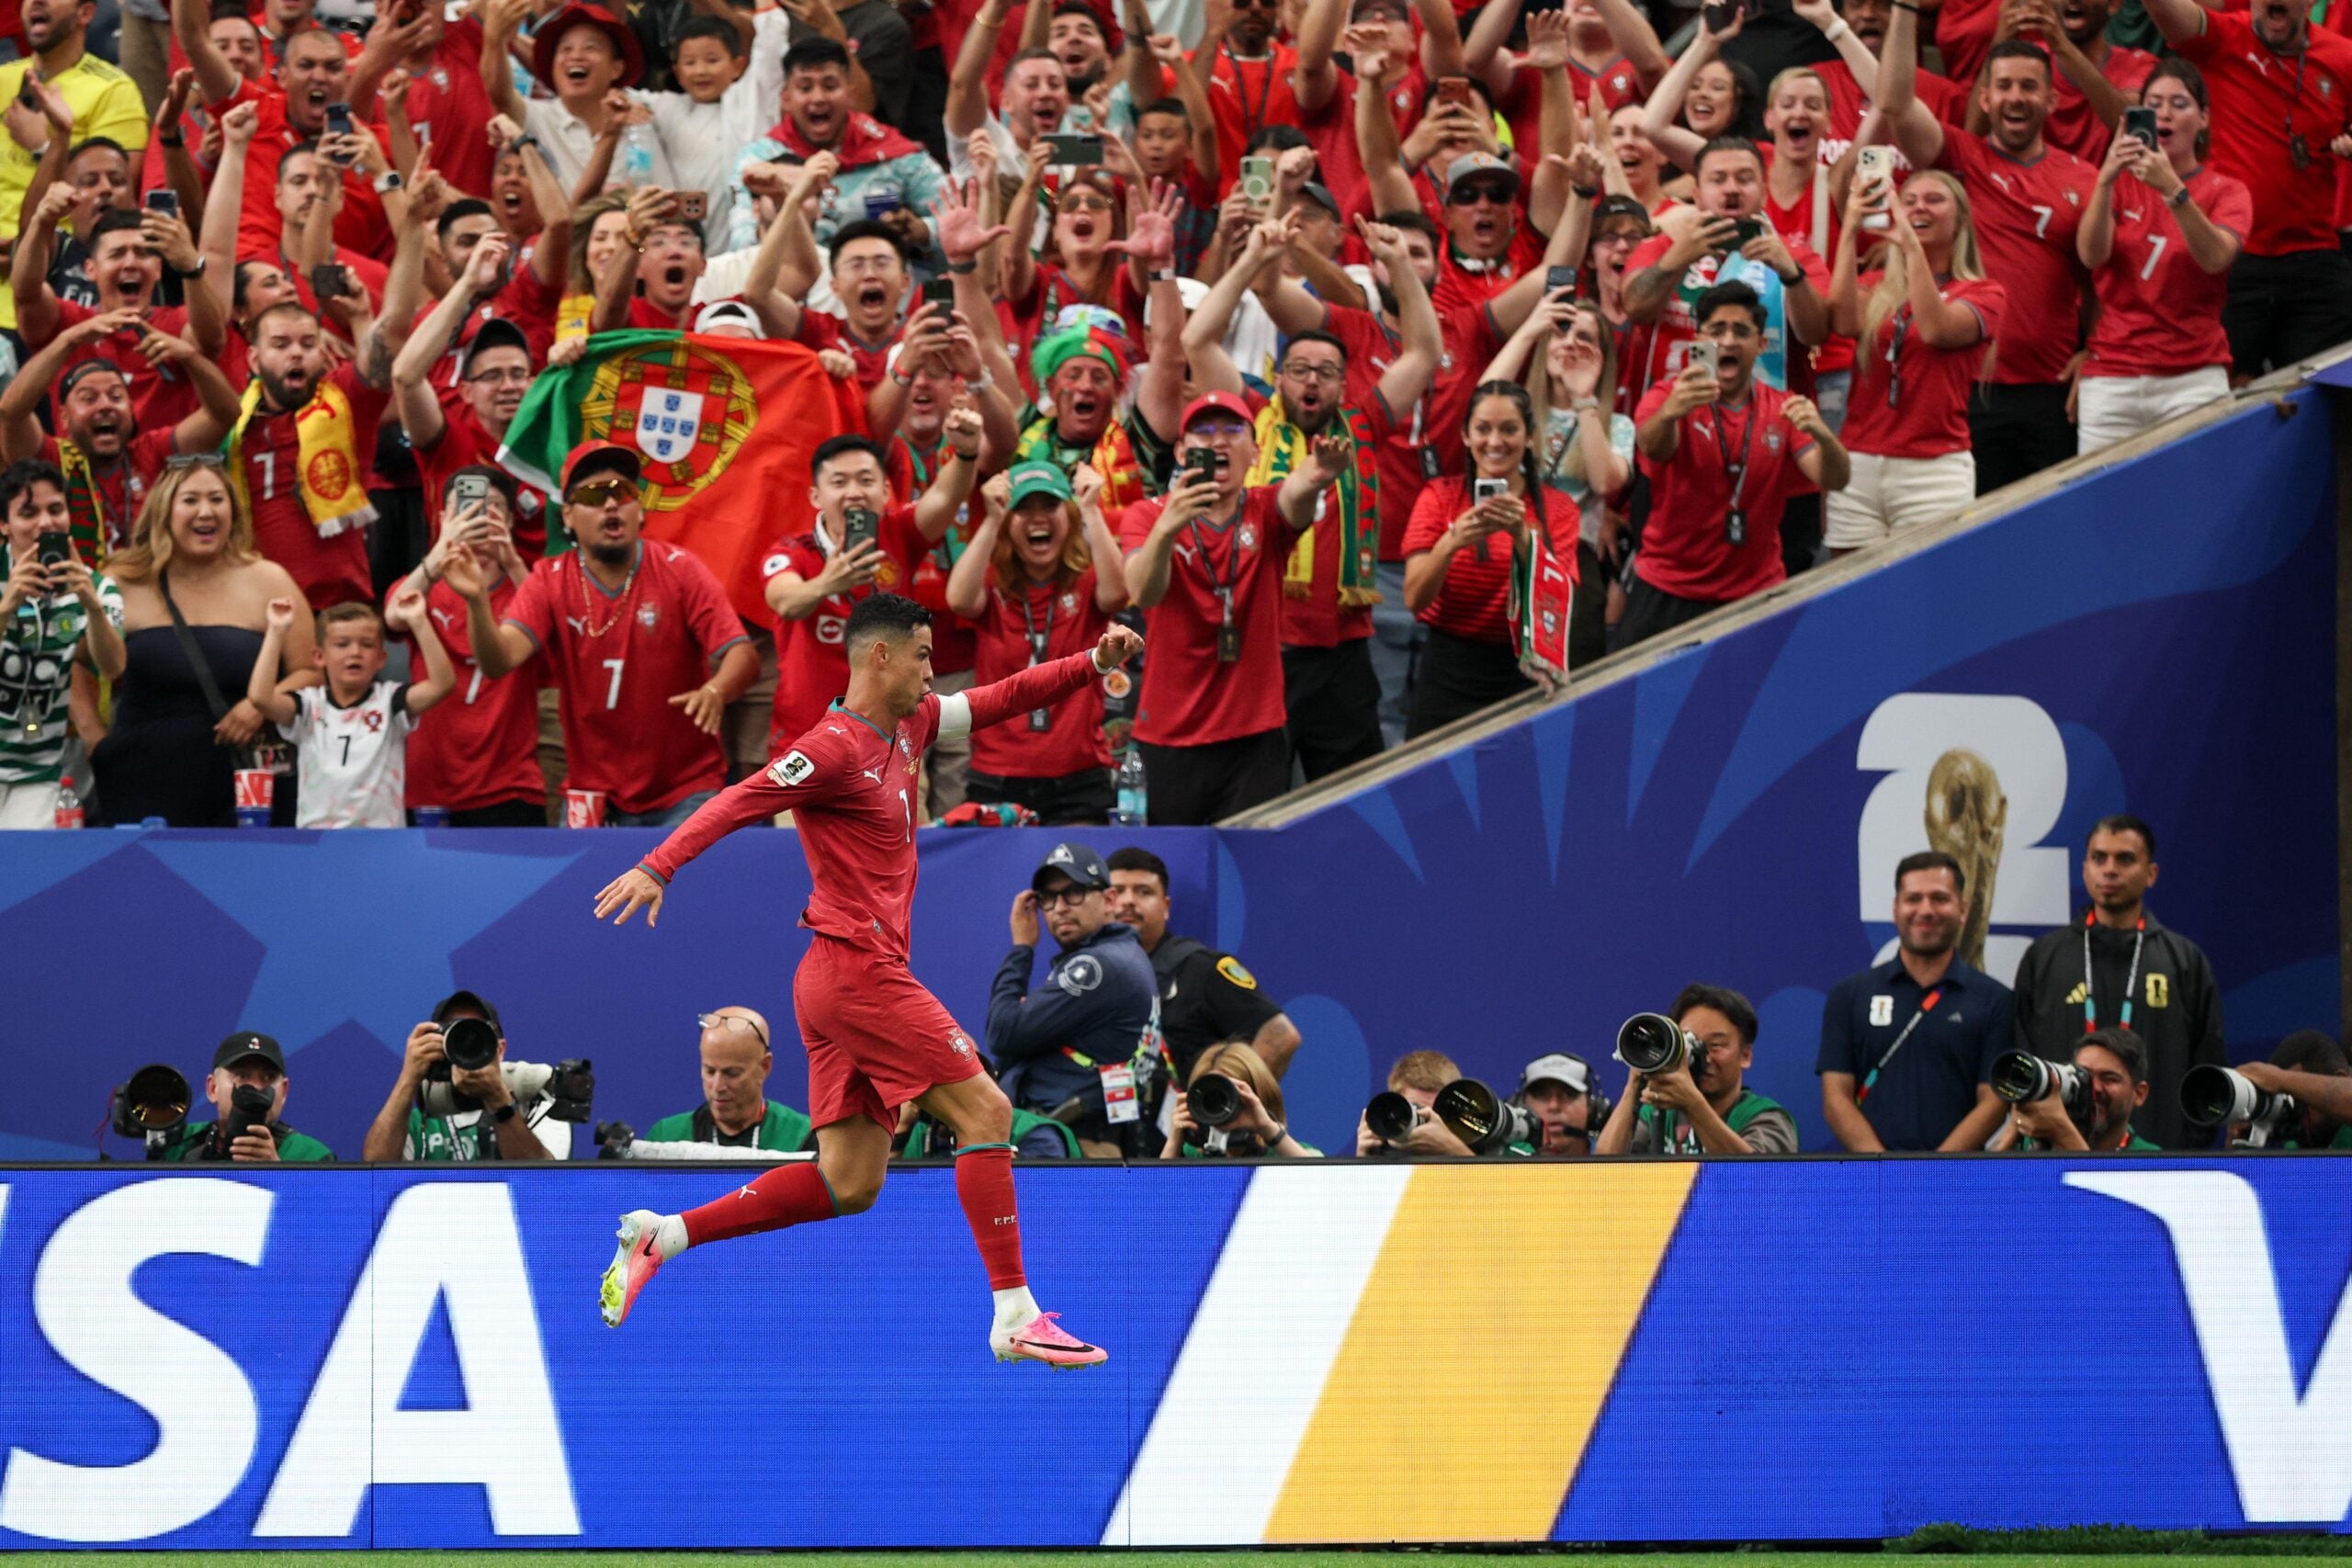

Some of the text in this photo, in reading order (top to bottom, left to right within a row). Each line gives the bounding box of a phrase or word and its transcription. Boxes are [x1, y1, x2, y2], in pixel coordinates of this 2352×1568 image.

[2031, 205, 2052, 239] 7
[2141, 233, 2167, 281] 7
[253, 452, 275, 501] 7
[603, 659, 626, 710] 7
[337, 735, 351, 767] 7
[0, 1177, 582, 1542] SA
